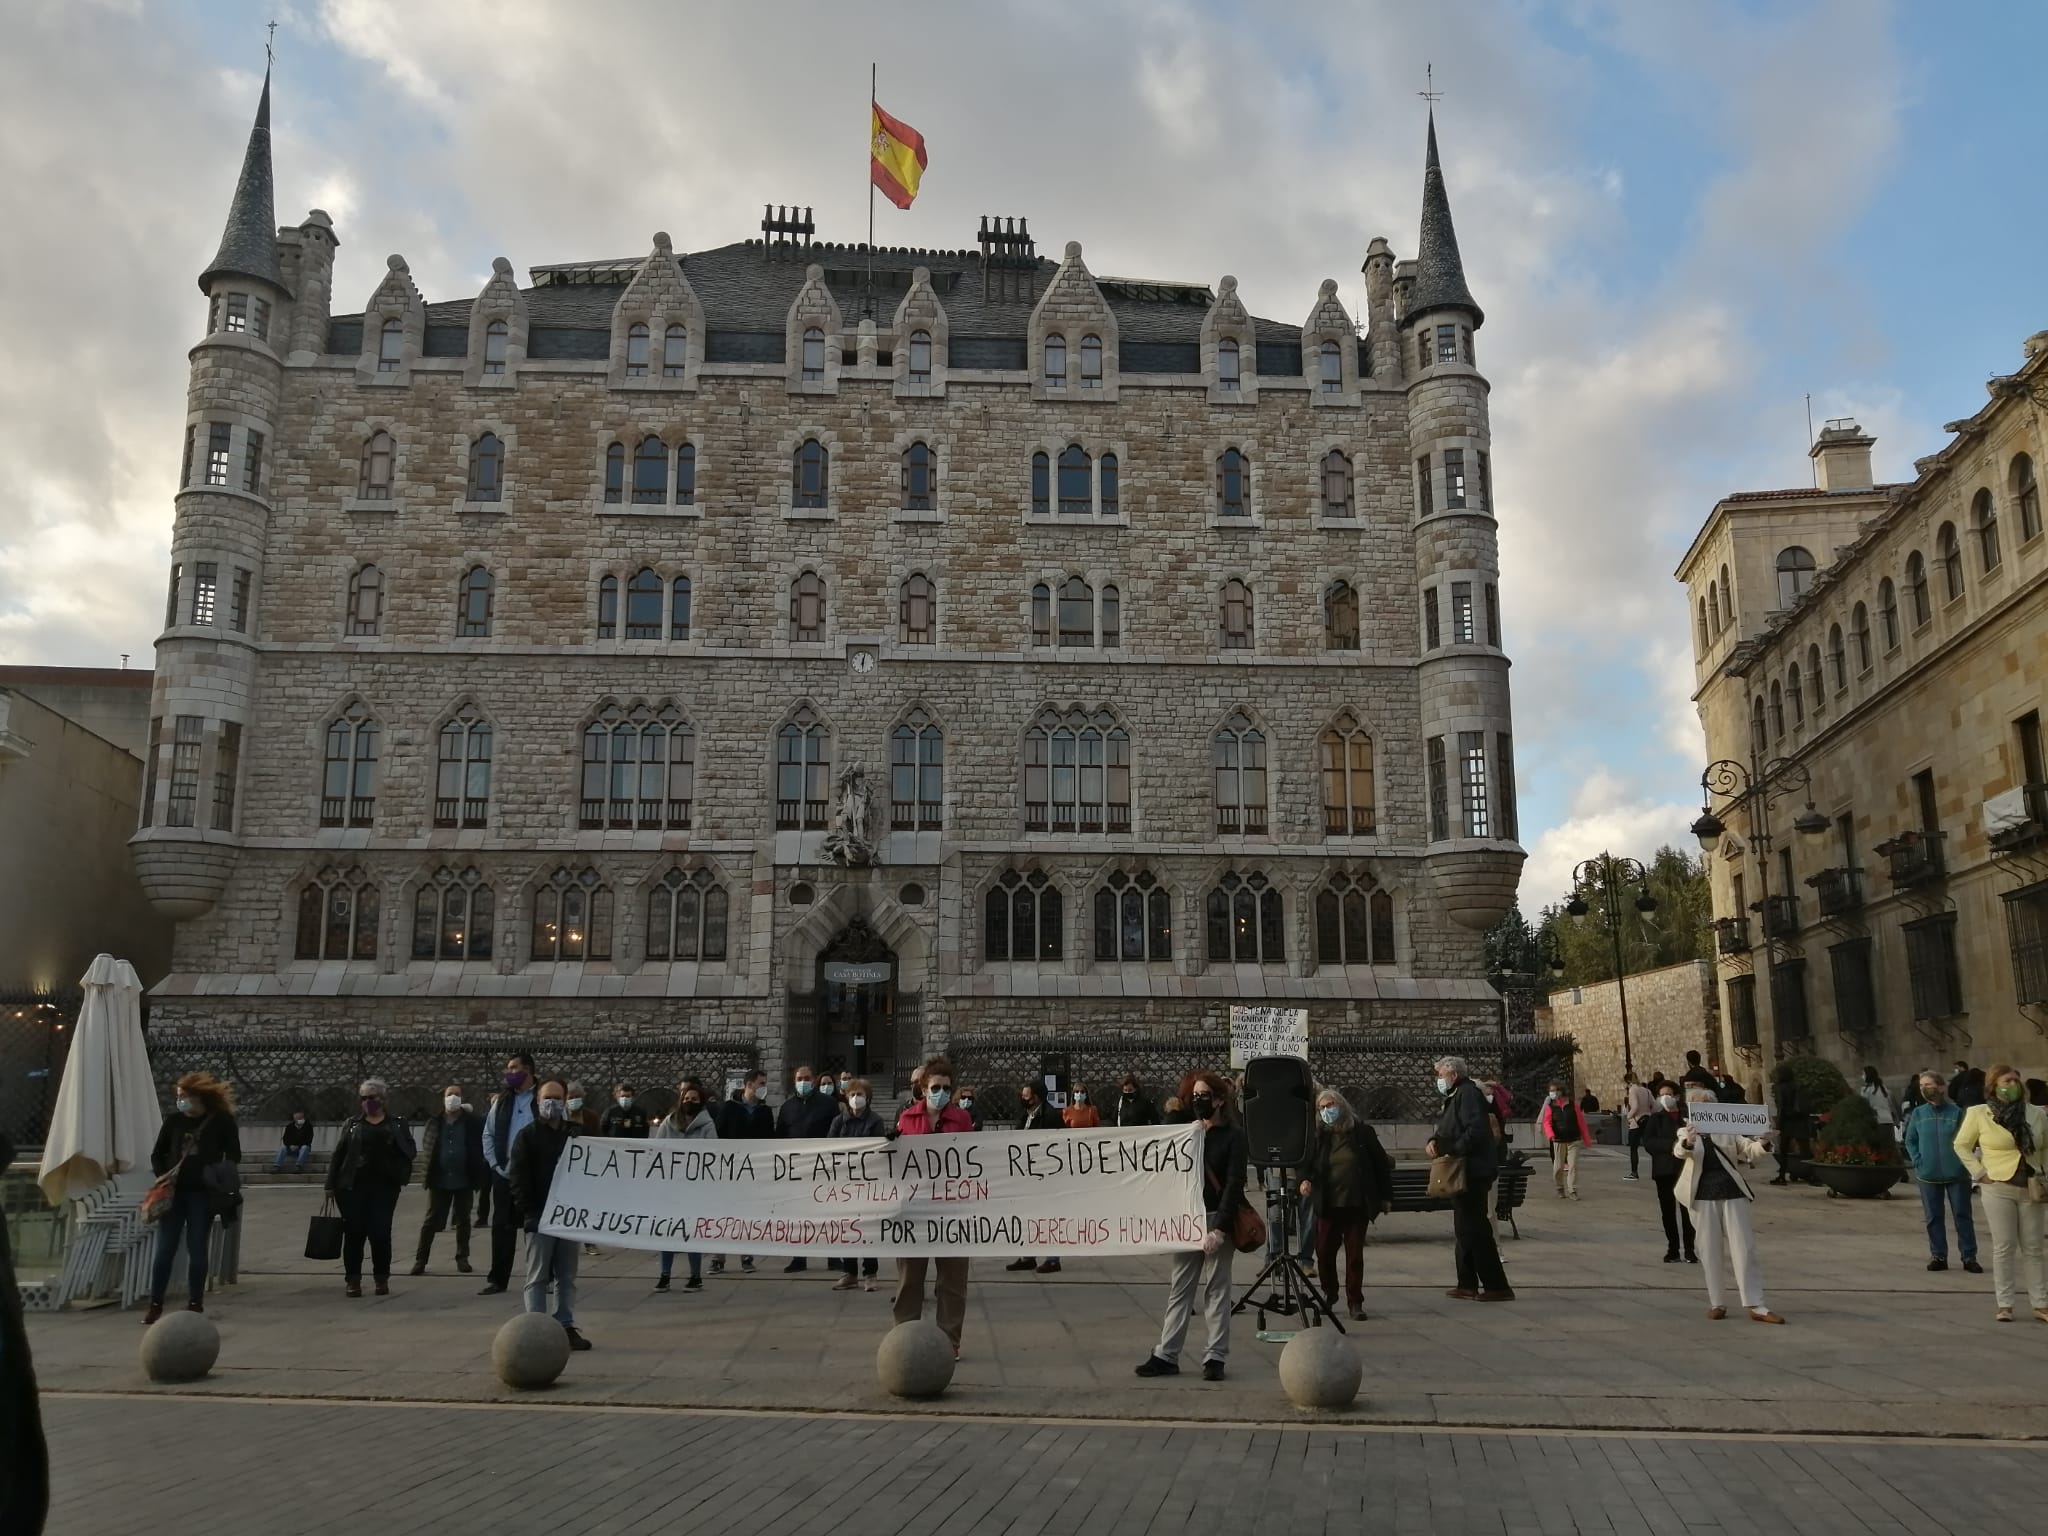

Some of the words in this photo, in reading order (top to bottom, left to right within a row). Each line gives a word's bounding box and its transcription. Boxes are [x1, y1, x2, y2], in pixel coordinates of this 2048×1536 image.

[1272, 1018, 1283, 1026] NO
[1288, 1018, 1297, 1026] SE
[1232, 1040, 1259, 1050] DESDE
[1263, 1042, 1279, 1051] QUE
[1282, 1044, 1300, 1053] UNO
[1714, 1112, 1729, 1122] CON
[1731, 1112, 1767, 1125] DIGNIDAD
[567, 1144, 755, 1181] PLATAFORMA
[774, 1152, 803, 1182] DE
[812, 1145, 984, 1183] AFECTADOS
[1008, 1138, 1194, 1181] RESIDENCIAS
[813, 1182, 898, 1203] CASTILLA
[908, 1183, 920, 1203] Y
[549, 1204, 589, 1229] POR
[880, 1218, 917, 1245] POR
[1027, 1216, 1110, 1245] DERECHOS
[1119, 1213, 1203, 1244] HUMANOS
